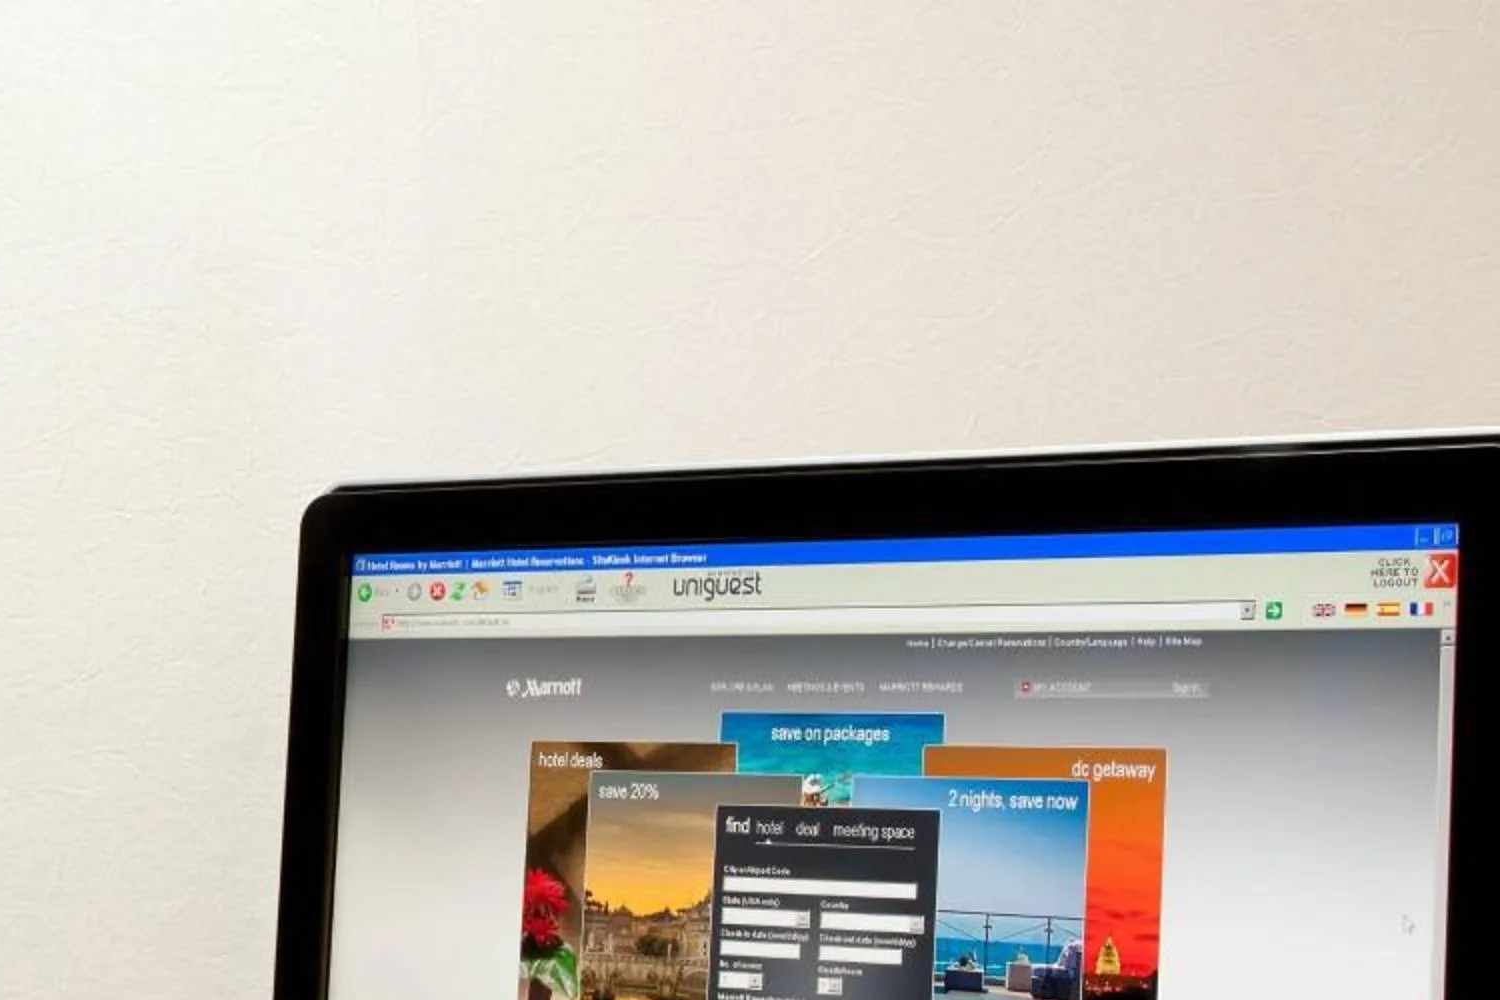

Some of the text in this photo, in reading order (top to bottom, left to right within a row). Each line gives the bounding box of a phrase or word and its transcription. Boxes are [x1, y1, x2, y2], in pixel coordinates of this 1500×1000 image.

[1376, 557, 1411, 567] CLICK
[1370, 567, 1419, 577] HERE TO
[672, 571, 762, 601] uniguest
[1373, 577, 1419, 588] LOGOUT
[771, 727, 891, 747] save on packages
[538, 752, 603, 769] hotel deals
[1071, 760, 1156, 783] dc getaway
[597, 783, 660, 801] save 20%
[947, 789, 1080, 812] 2 nights, save now
[725, 816, 916, 841] find hotel deal meeting space
